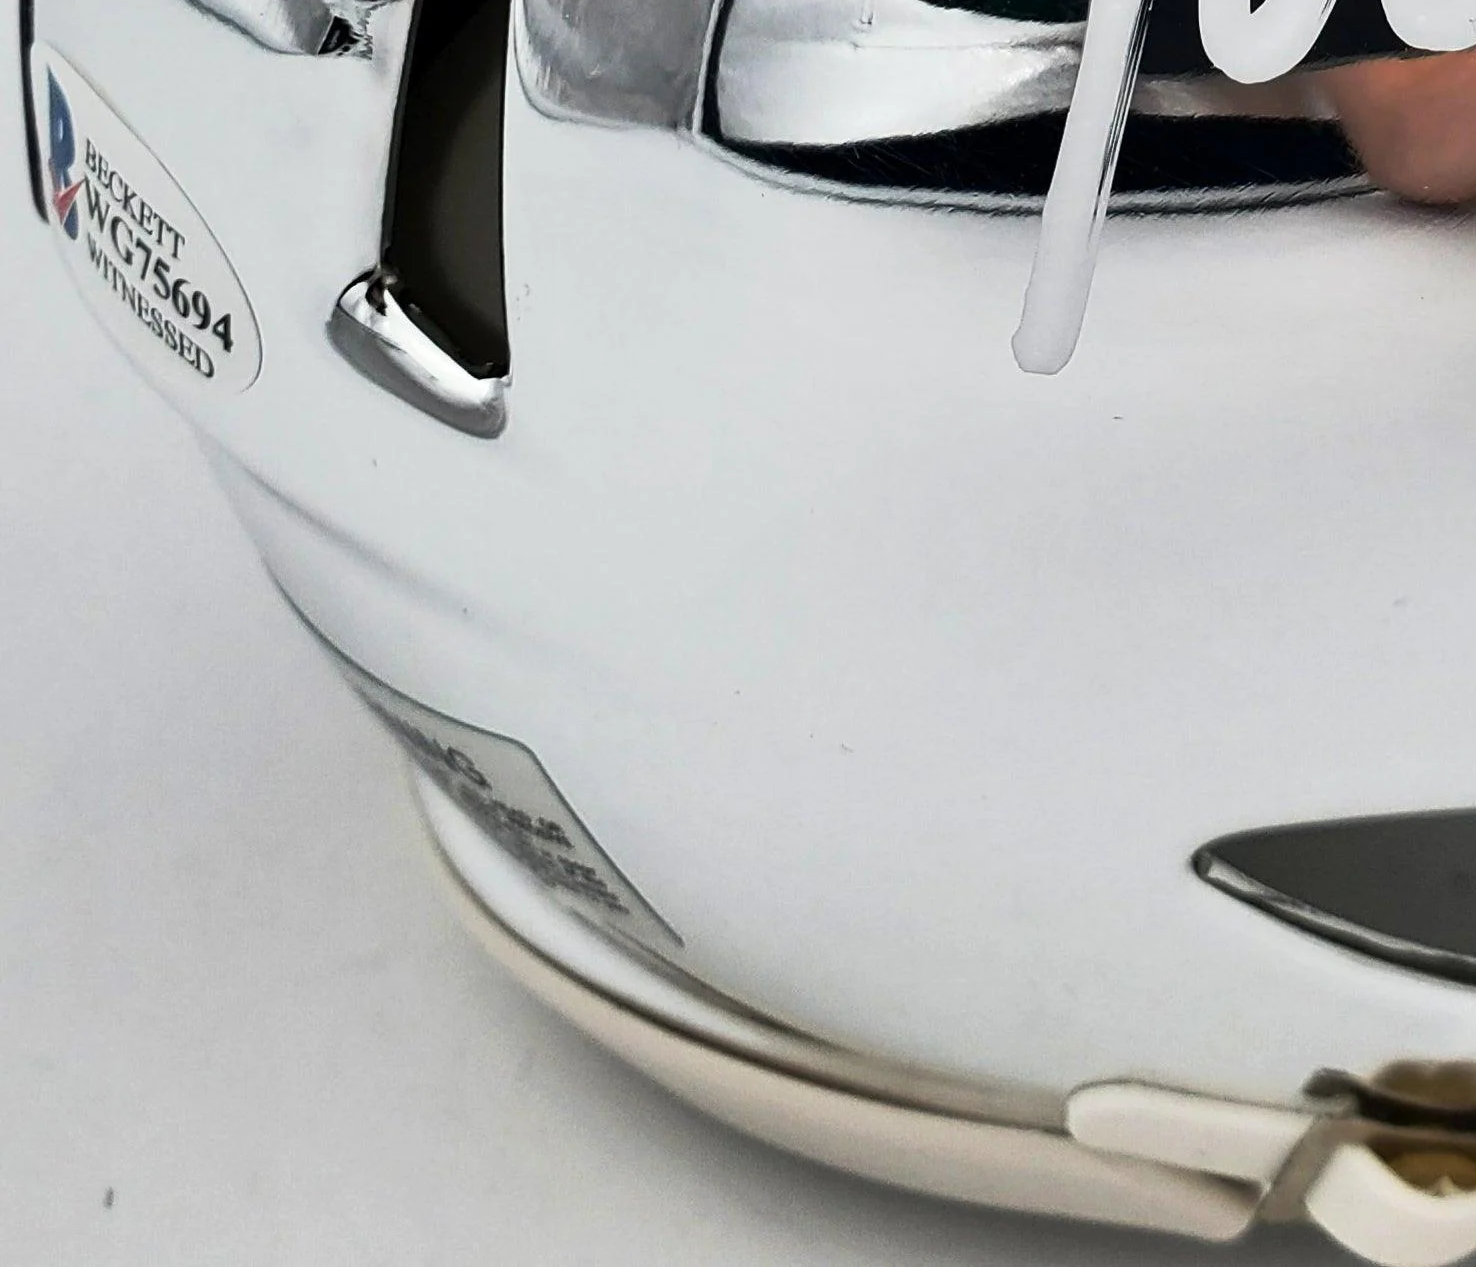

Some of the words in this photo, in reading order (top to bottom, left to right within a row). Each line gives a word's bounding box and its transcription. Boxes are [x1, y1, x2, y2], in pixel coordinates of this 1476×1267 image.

[83, 174, 234, 353] WG75694
[84, 136, 186, 261] BECKETT
[87, 231, 215, 379] WITNESSED
